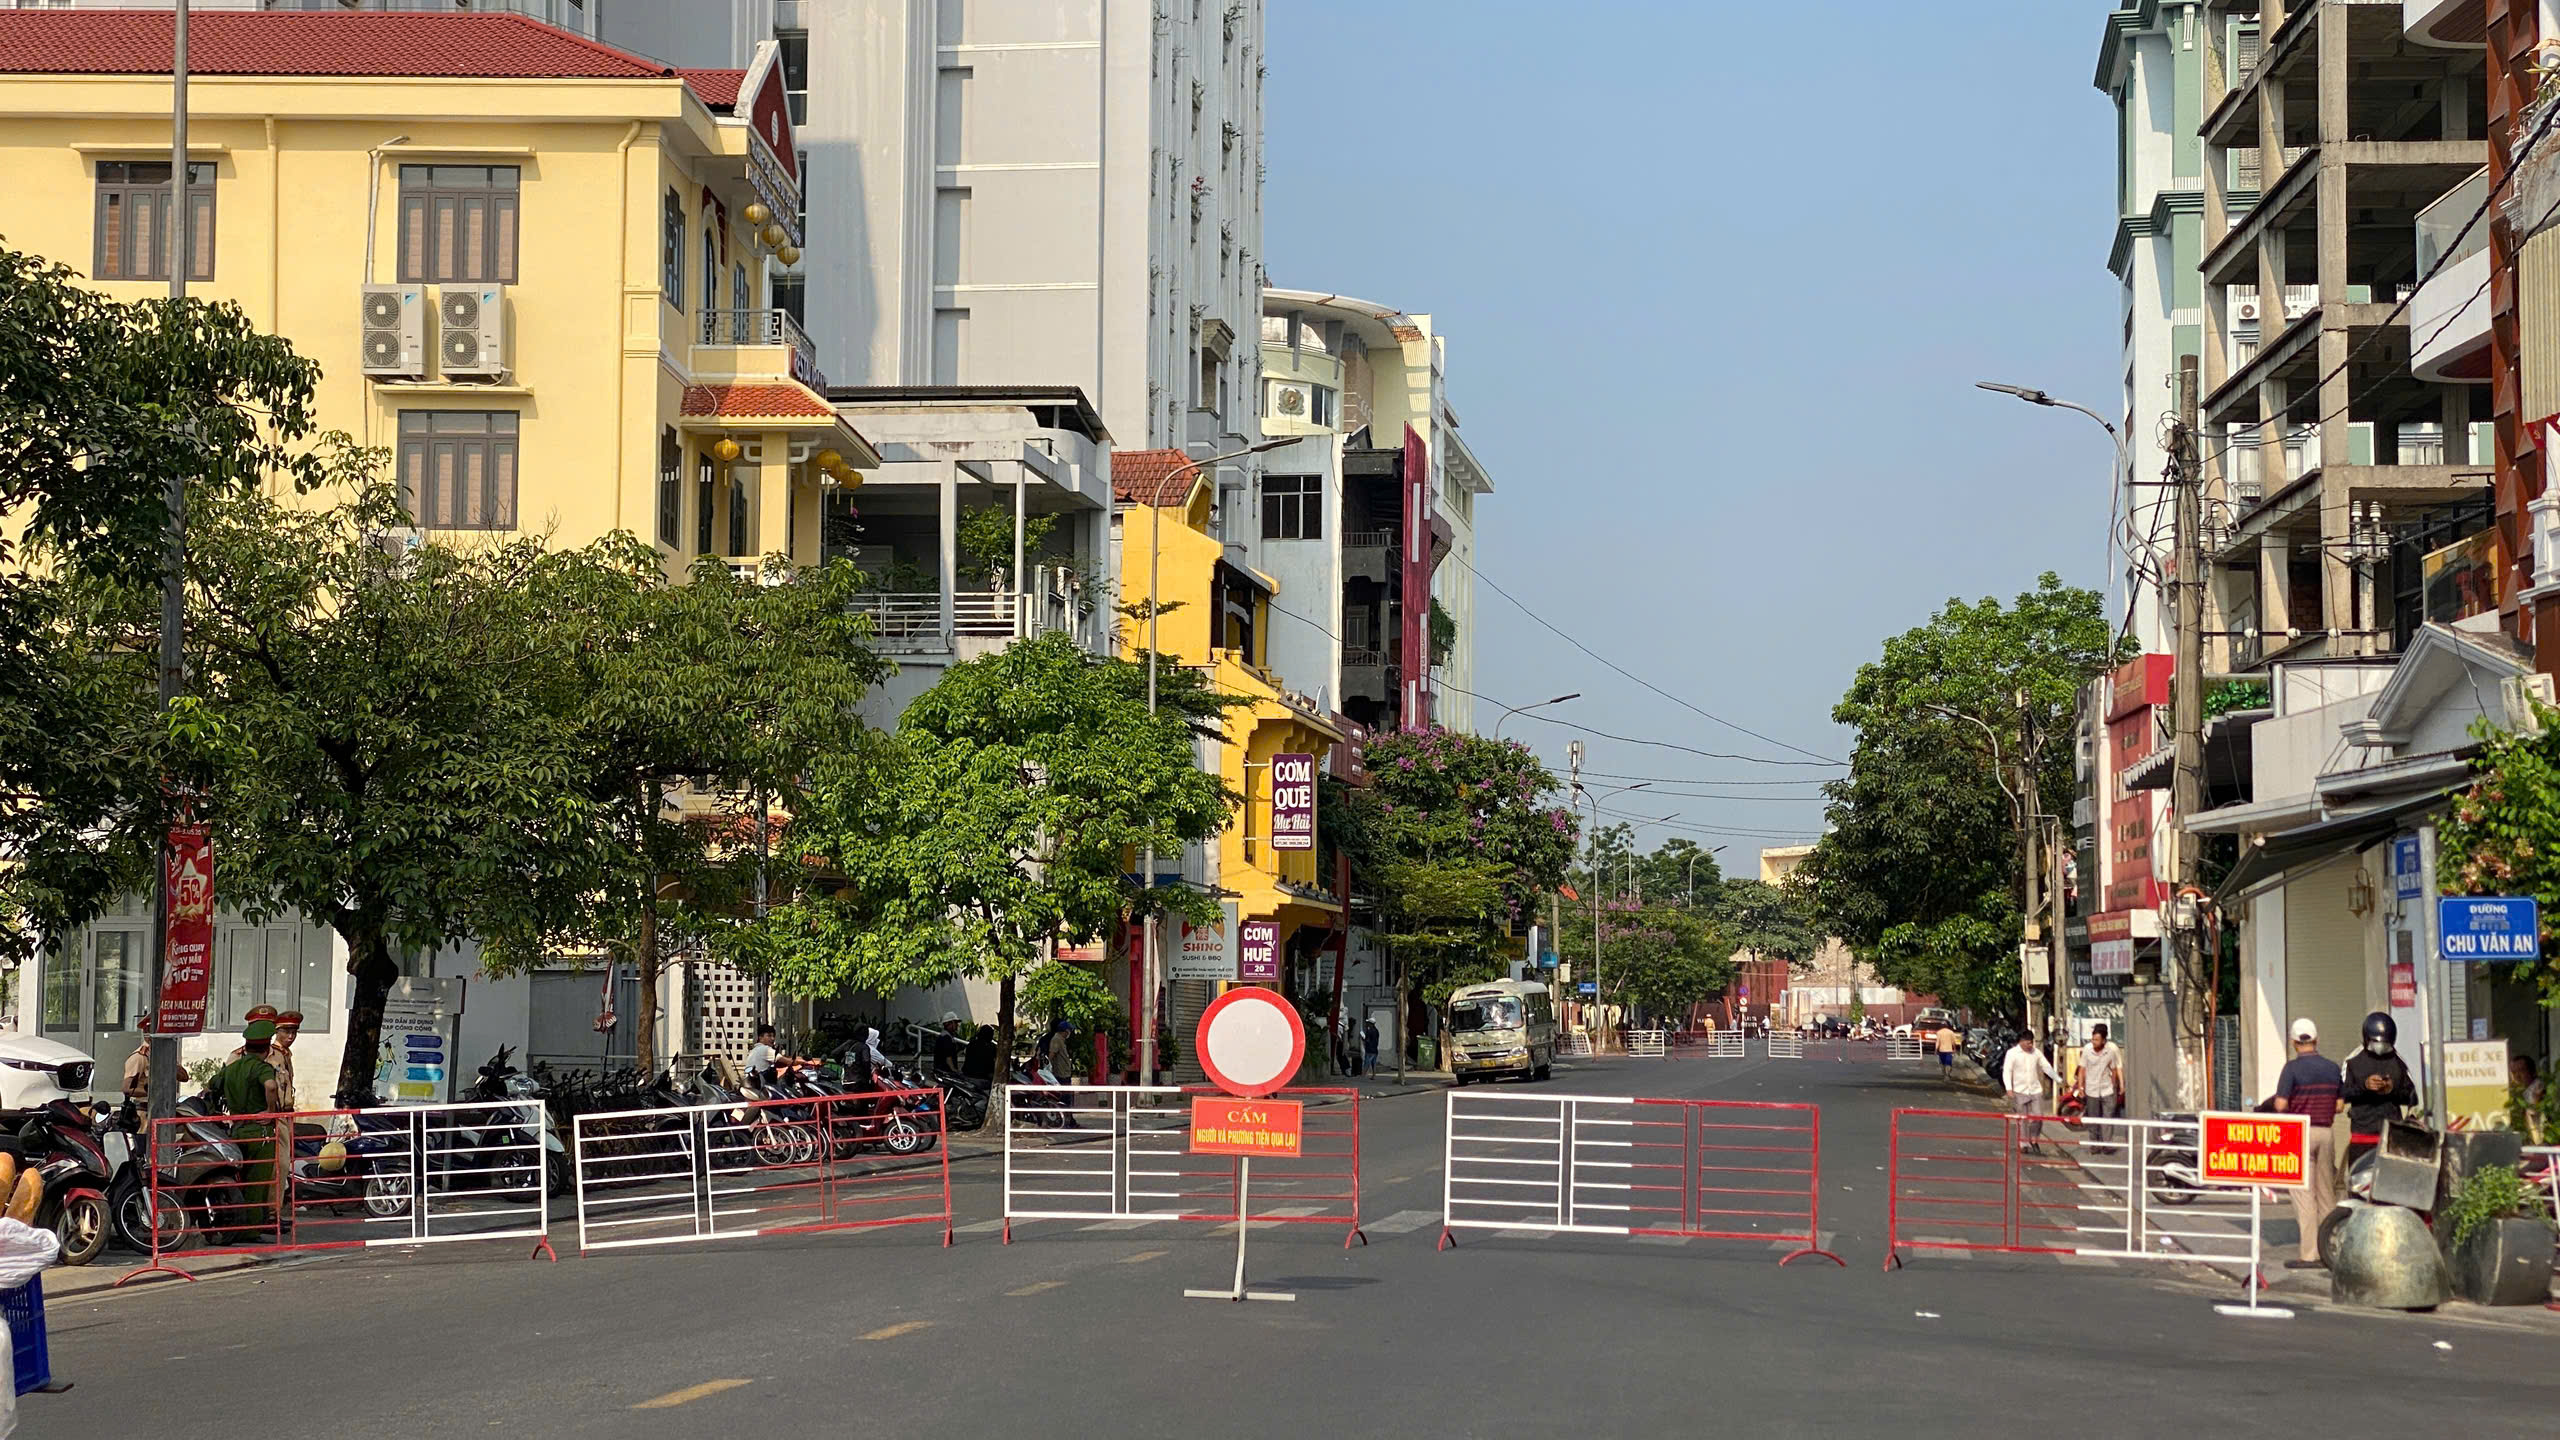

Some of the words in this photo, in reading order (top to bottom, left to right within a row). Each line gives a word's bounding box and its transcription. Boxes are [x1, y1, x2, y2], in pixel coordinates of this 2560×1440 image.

[1275, 759, 1311, 782] CƠM
[2469, 903, 2508, 914] ĐƯỜNG
[1183, 943, 1223, 952] SHINO
[2446, 935, 2476, 952] CHU
[2480, 931, 2510, 952] VĂN
[2514, 935, 2533, 952] AN
[2447, 1066, 2497, 1078] ARKING
[1227, 1106, 1267, 1124] CẤM
[1196, 1126, 1217, 1143] NGƯỜI
[1218, 1127, 1227, 1144] VÀ
[1256, 1129, 1270, 1148] TIỆN
[1271, 1132, 1283, 1147] QUA
[1285, 1133, 1296, 1149] LẠI
[2227, 1123, 2253, 1142] KHU
[2255, 1124, 2281, 1148] VỰC
[2209, 1147, 2238, 1170] CẤM
[2240, 1152, 2268, 1175] TẠM
[2271, 1151, 2299, 1174] THỜI
